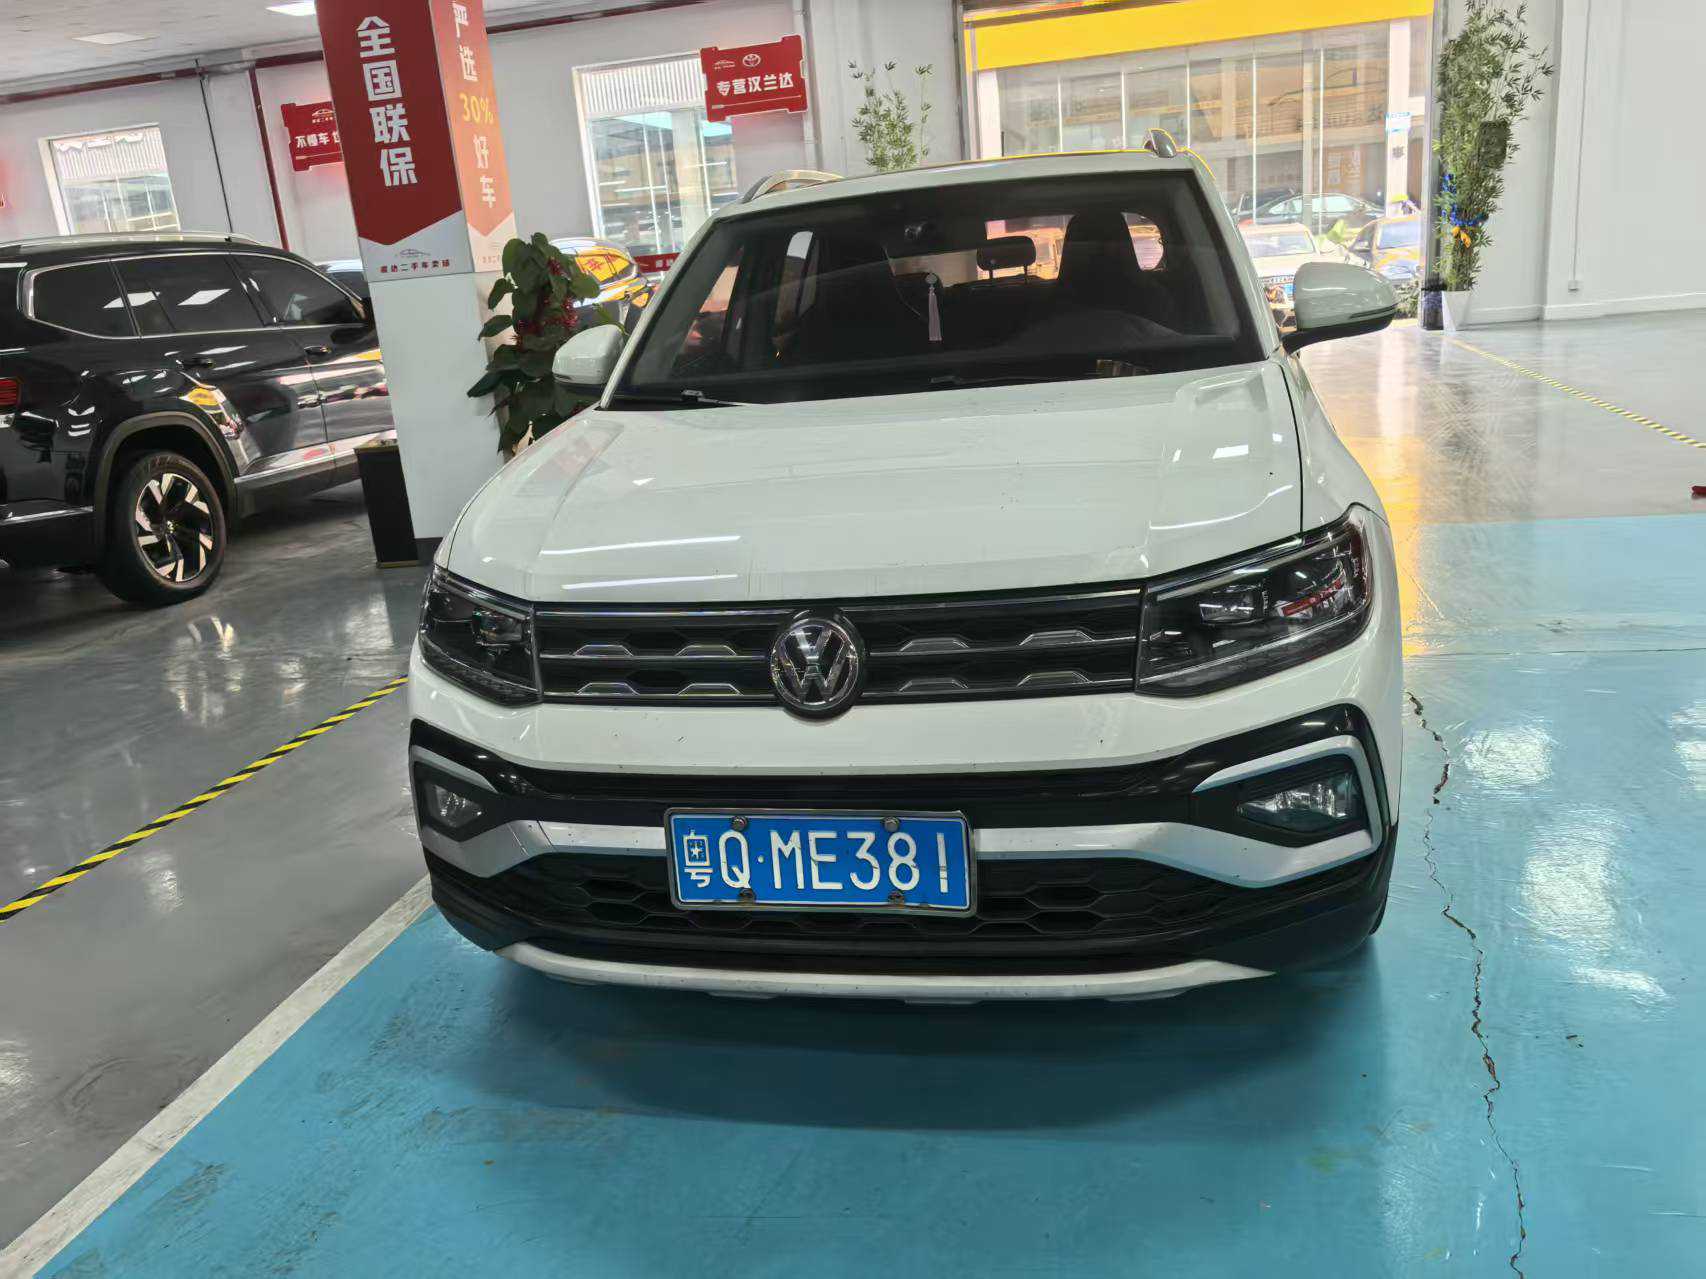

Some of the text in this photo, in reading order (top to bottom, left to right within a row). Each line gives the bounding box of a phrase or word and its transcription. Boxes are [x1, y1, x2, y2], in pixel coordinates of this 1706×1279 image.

[356, 15, 418, 187] 全国联保
[716, 72, 794, 96] 专营汉兰达
